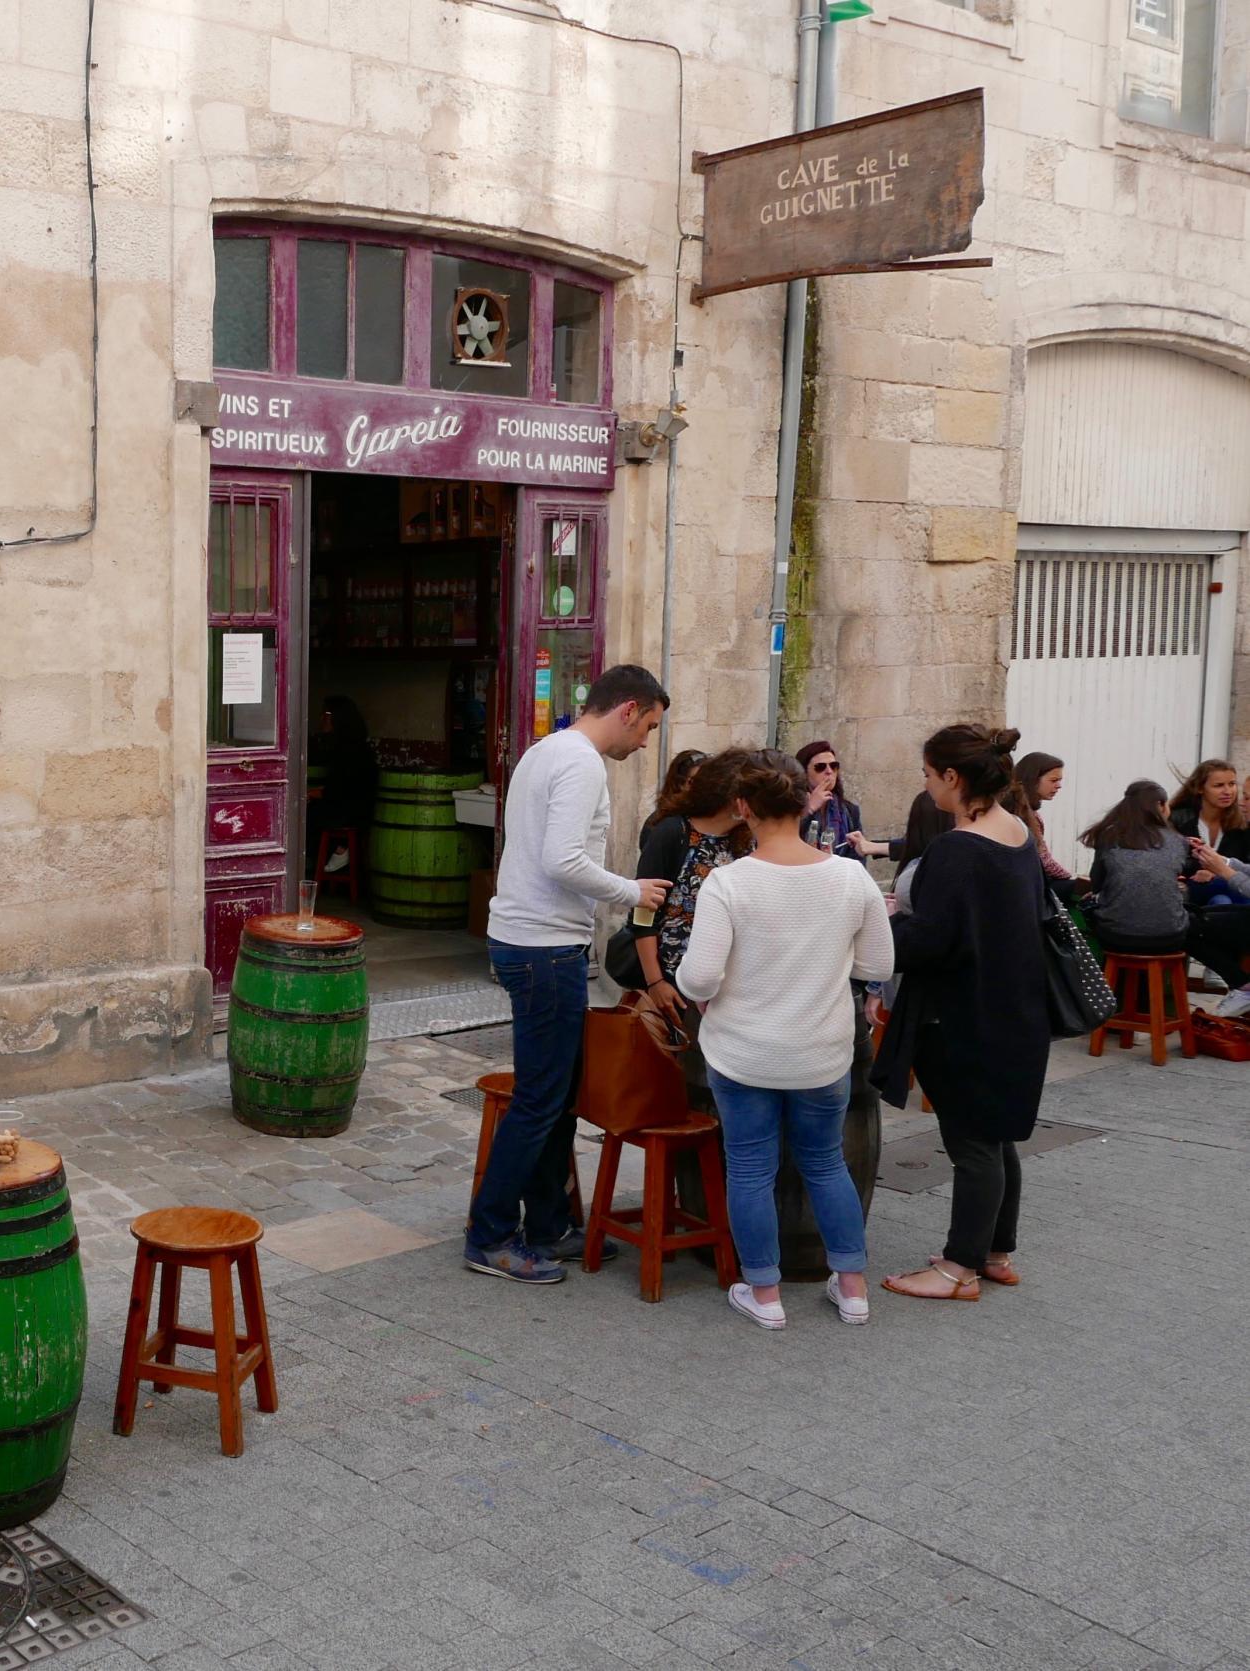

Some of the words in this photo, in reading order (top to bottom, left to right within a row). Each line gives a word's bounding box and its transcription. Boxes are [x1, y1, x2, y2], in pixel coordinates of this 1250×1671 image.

[777, 154, 839, 190] CAVE
[856, 157, 878, 175] de
[760, 172, 896, 225] GUIGNETTE
[268, 398, 292, 418] ET
[211, 427, 326, 455] SPIRITUEUX
[346, 406, 462, 468] Garcia
[497, 418, 609, 444] FOURNISSEUR
[477, 449, 521, 468] POUR
[526, 452, 545, 470] LA
[549, 454, 608, 475] MARINE
